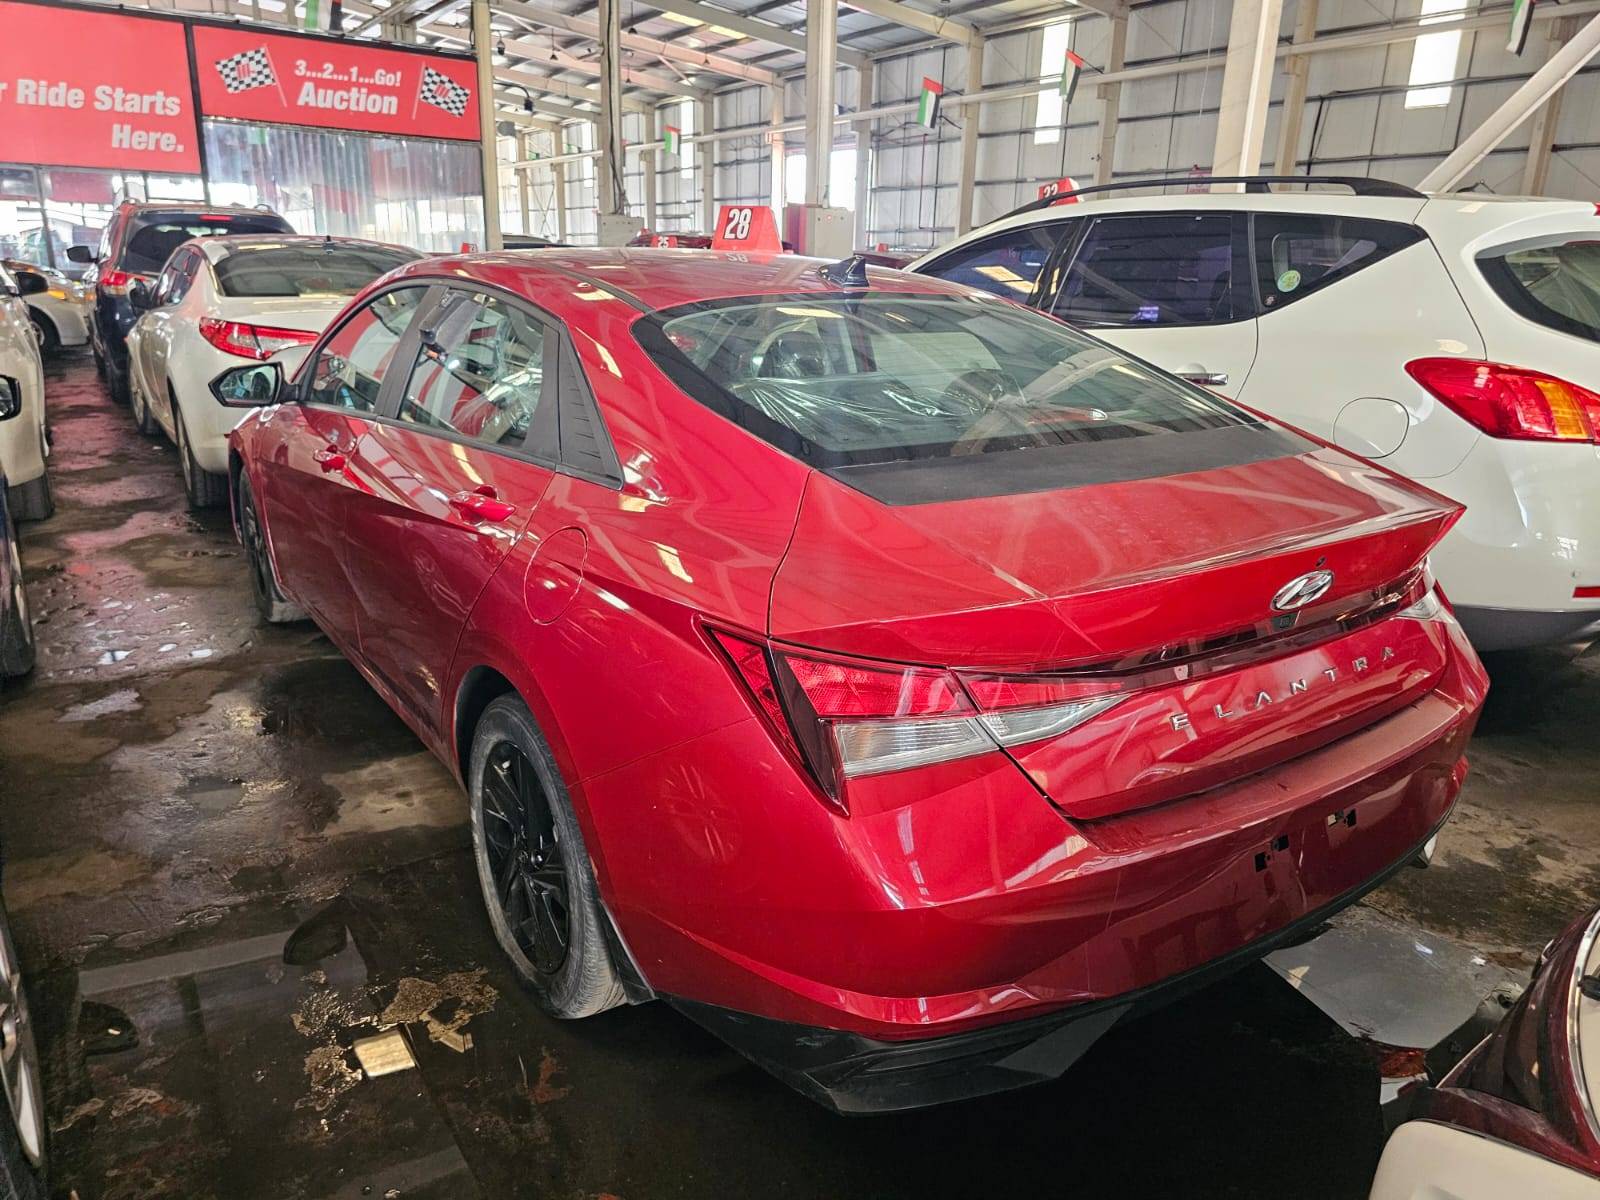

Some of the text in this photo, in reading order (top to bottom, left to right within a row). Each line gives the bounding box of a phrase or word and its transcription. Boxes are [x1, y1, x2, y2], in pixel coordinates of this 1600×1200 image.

[16, 79, 85, 109] Ride
[93, 85, 181, 116] Starts
[297, 82, 398, 115] Auction
[111, 123, 185, 153] Here.
[724, 208, 752, 240] 28
[1169, 647, 1395, 732] ELANTRA
